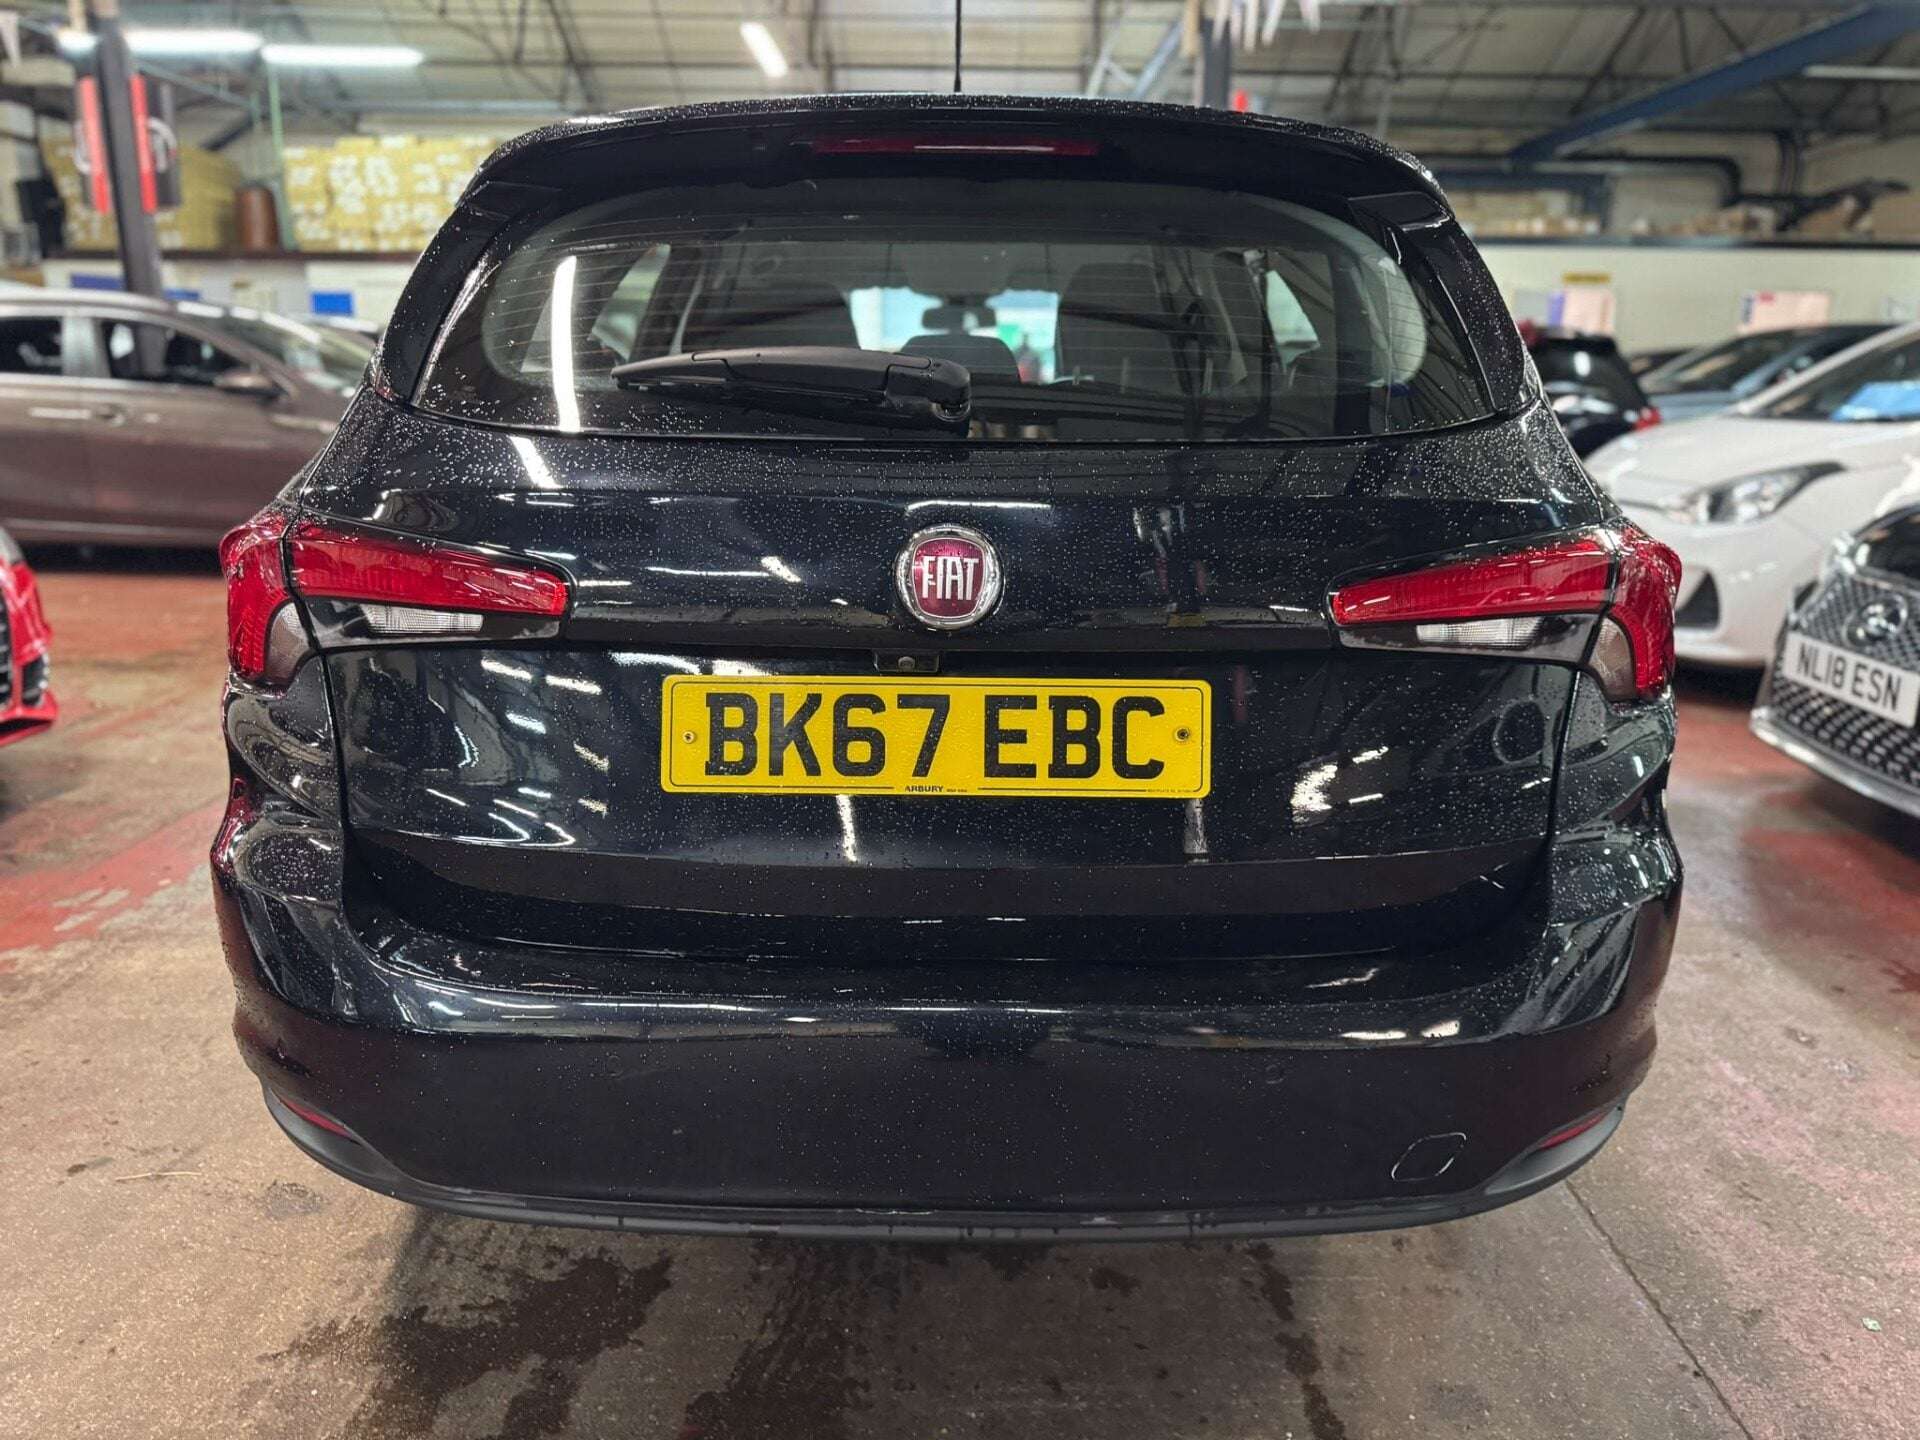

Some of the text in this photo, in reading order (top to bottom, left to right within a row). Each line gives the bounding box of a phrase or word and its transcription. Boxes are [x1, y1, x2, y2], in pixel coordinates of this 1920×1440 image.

[921, 555, 980, 601] FIAT
[1799, 644, 1902, 711] NL18 ESN
[704, 692, 1165, 780] BK67 EBC
[905, 785, 944, 793] ARBURY
